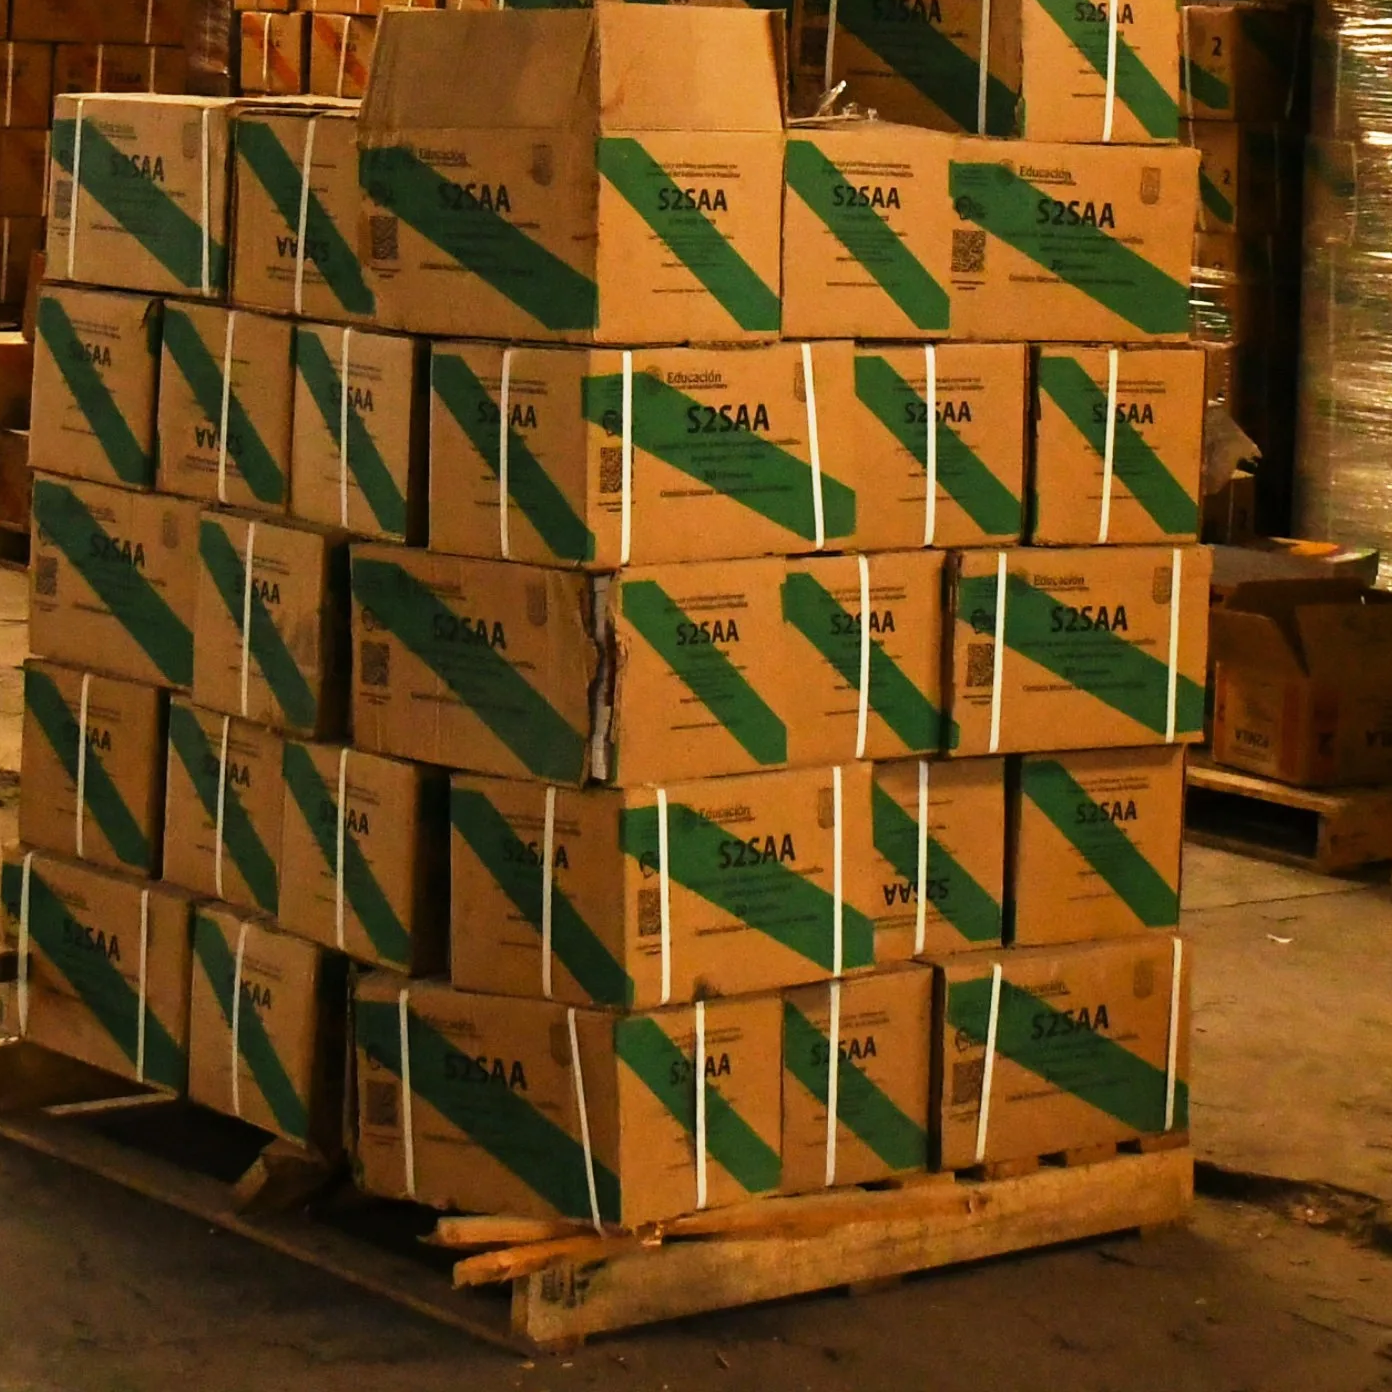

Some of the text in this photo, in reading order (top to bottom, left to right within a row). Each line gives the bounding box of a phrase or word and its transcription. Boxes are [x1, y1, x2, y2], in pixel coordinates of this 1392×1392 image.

[1211, 36, 1223, 57] 2
[1019, 165, 1072, 180] Educación
[437, 182, 511, 213] S2SAA
[659, 188, 727, 212] S2SAA
[832, 185, 900, 209] S2SAA
[1036, 198, 1115, 229] S2SAA
[667, 371, 721, 383] Educación
[328, 383, 374, 413] SSAA
[476, 404, 539, 430] S2AA
[687, 404, 769, 433] S2SAA
[1093, 402, 1154, 425] SSAA
[434, 614, 506, 650] S2SAA
[1051, 605, 1128, 632] S2SAA
[677, 620, 739, 645] S2SAA
[1075, 801, 1138, 823] S2SAA
[718, 834, 796, 868] S2SAA
[1031, 1006, 1109, 1040] S2SAA
[445, 1055, 527, 1090] S2SAA
[670, 1054, 731, 1085] S2AA
